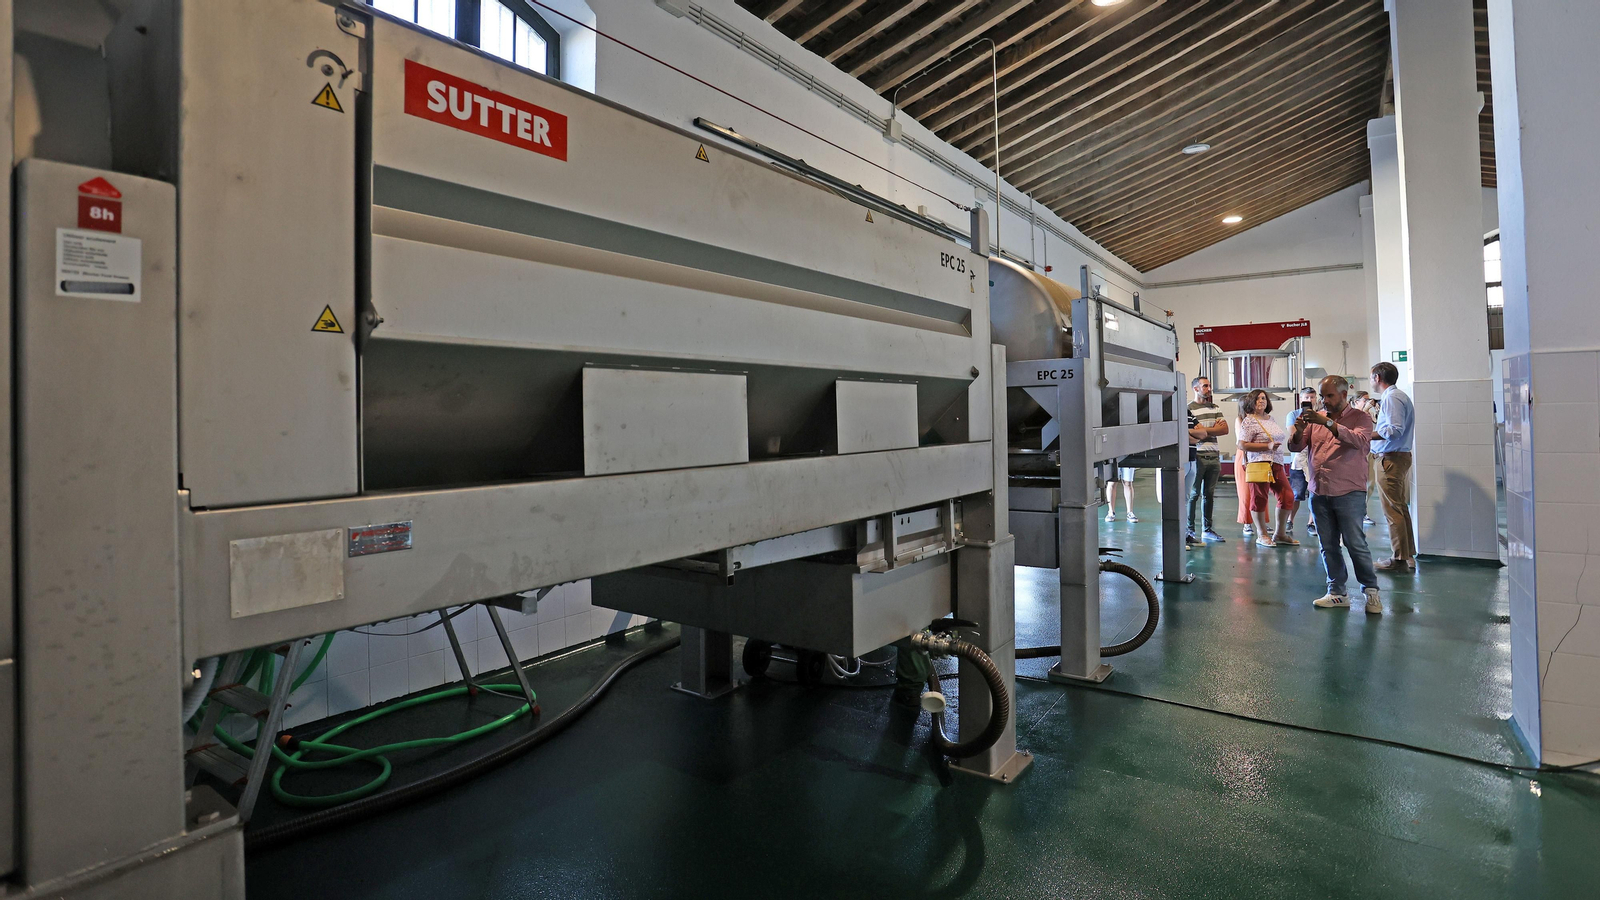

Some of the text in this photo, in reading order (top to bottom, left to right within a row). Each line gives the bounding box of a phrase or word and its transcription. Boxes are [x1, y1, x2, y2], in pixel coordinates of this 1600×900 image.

[427, 80, 552, 147] SUTTER
[90, 206, 115, 221] 8h
[940, 252, 966, 273] EPC 25
[1037, 369, 1074, 380] EPC 25
